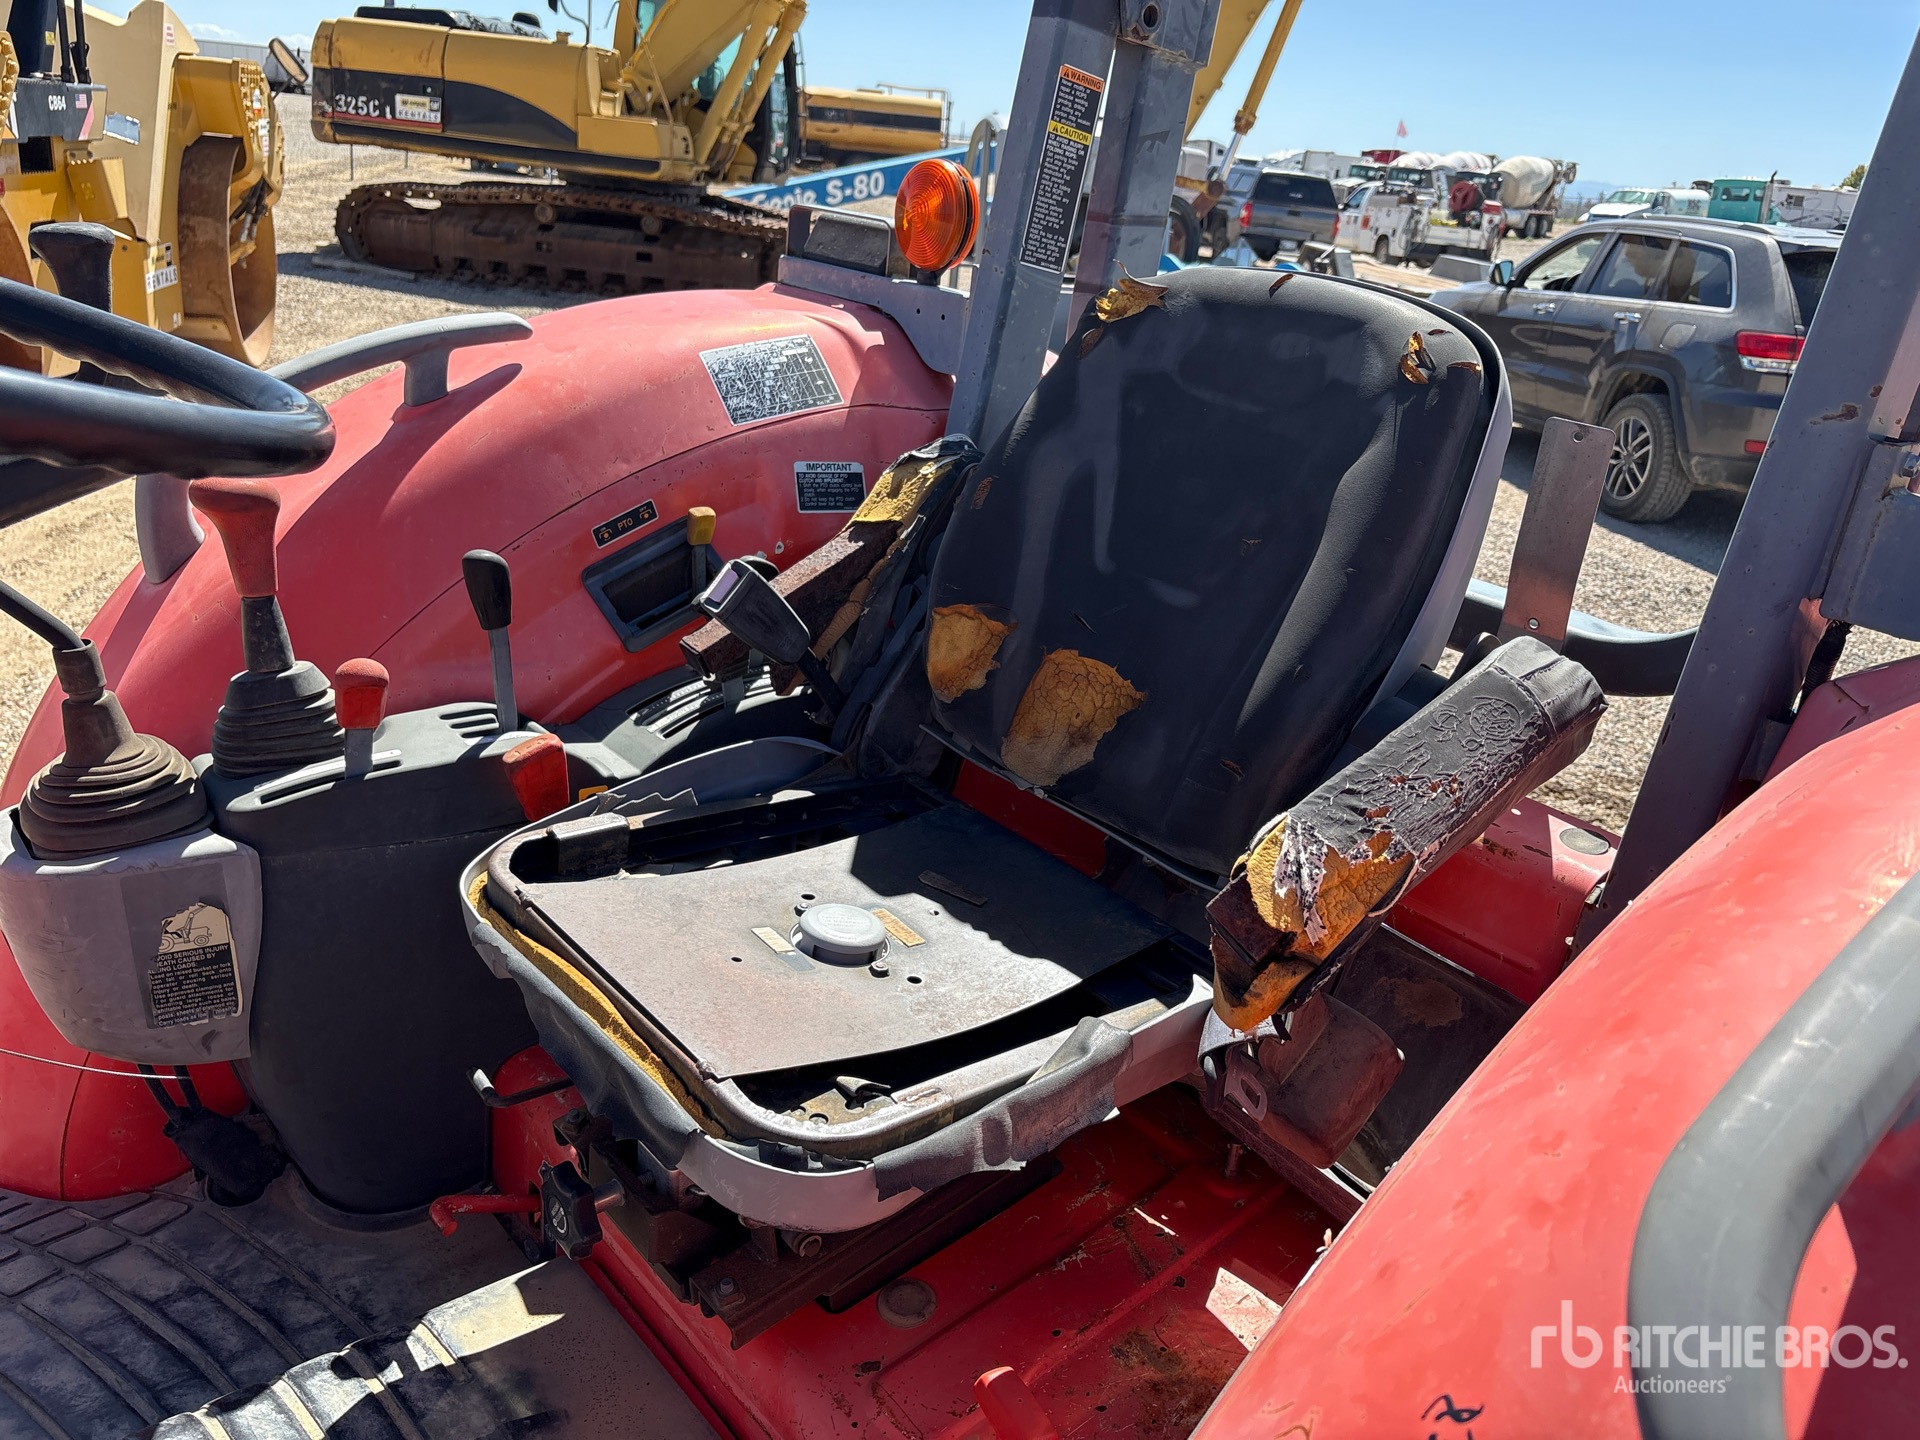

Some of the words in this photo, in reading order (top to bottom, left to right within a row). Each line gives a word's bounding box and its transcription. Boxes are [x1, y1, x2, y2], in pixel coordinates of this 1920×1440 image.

[1071, 71, 1101, 90] WARNING
[334, 94, 380, 117] 325C
[1060, 126, 1088, 143] CAUTION
[825, 171, 886, 206] S-80
[617, 517, 633, 531] PTO
[174, 949, 203, 958] SERIOUS
[205, 945, 229, 953] INJURY
[178, 955, 205, 963] CAUSED
